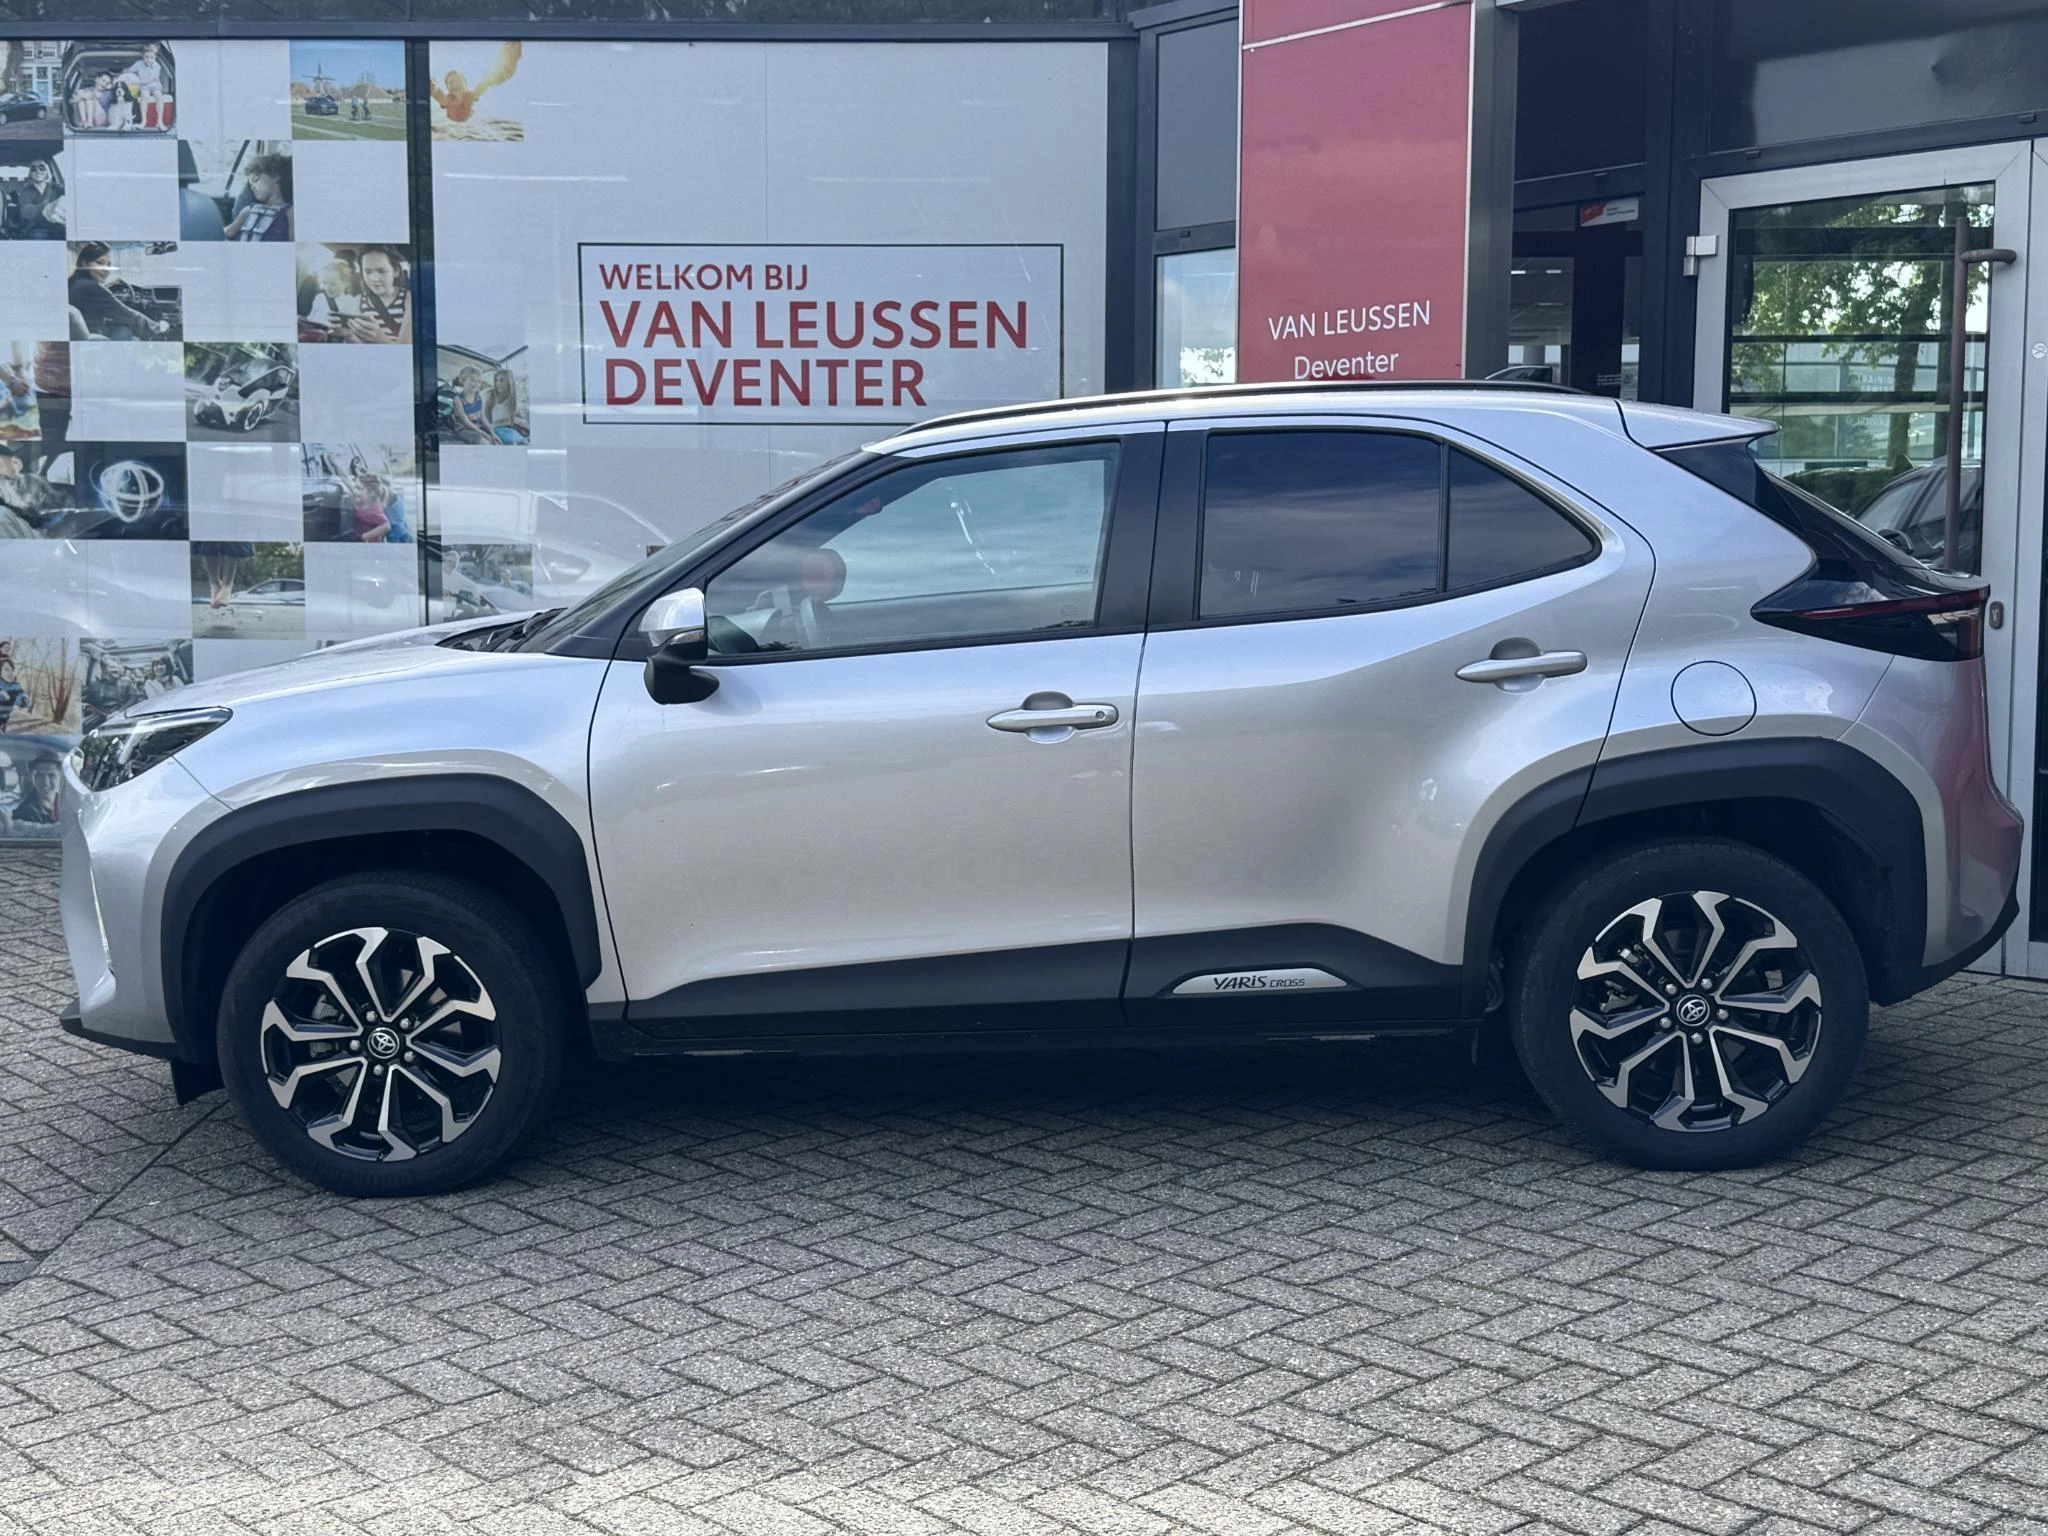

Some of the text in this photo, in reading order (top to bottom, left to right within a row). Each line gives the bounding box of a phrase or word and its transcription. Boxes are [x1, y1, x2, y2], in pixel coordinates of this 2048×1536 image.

[599, 264, 808, 290] WELKOM BIJ
[600, 300, 1027, 349] VAN LEUSSEN
[1268, 300, 1431, 341] VAN LEUSSEN
[606, 358, 927, 406] DEVENTER
[1294, 351, 1400, 380] Deventer
[1269, 978, 1306, 988] CROSS
